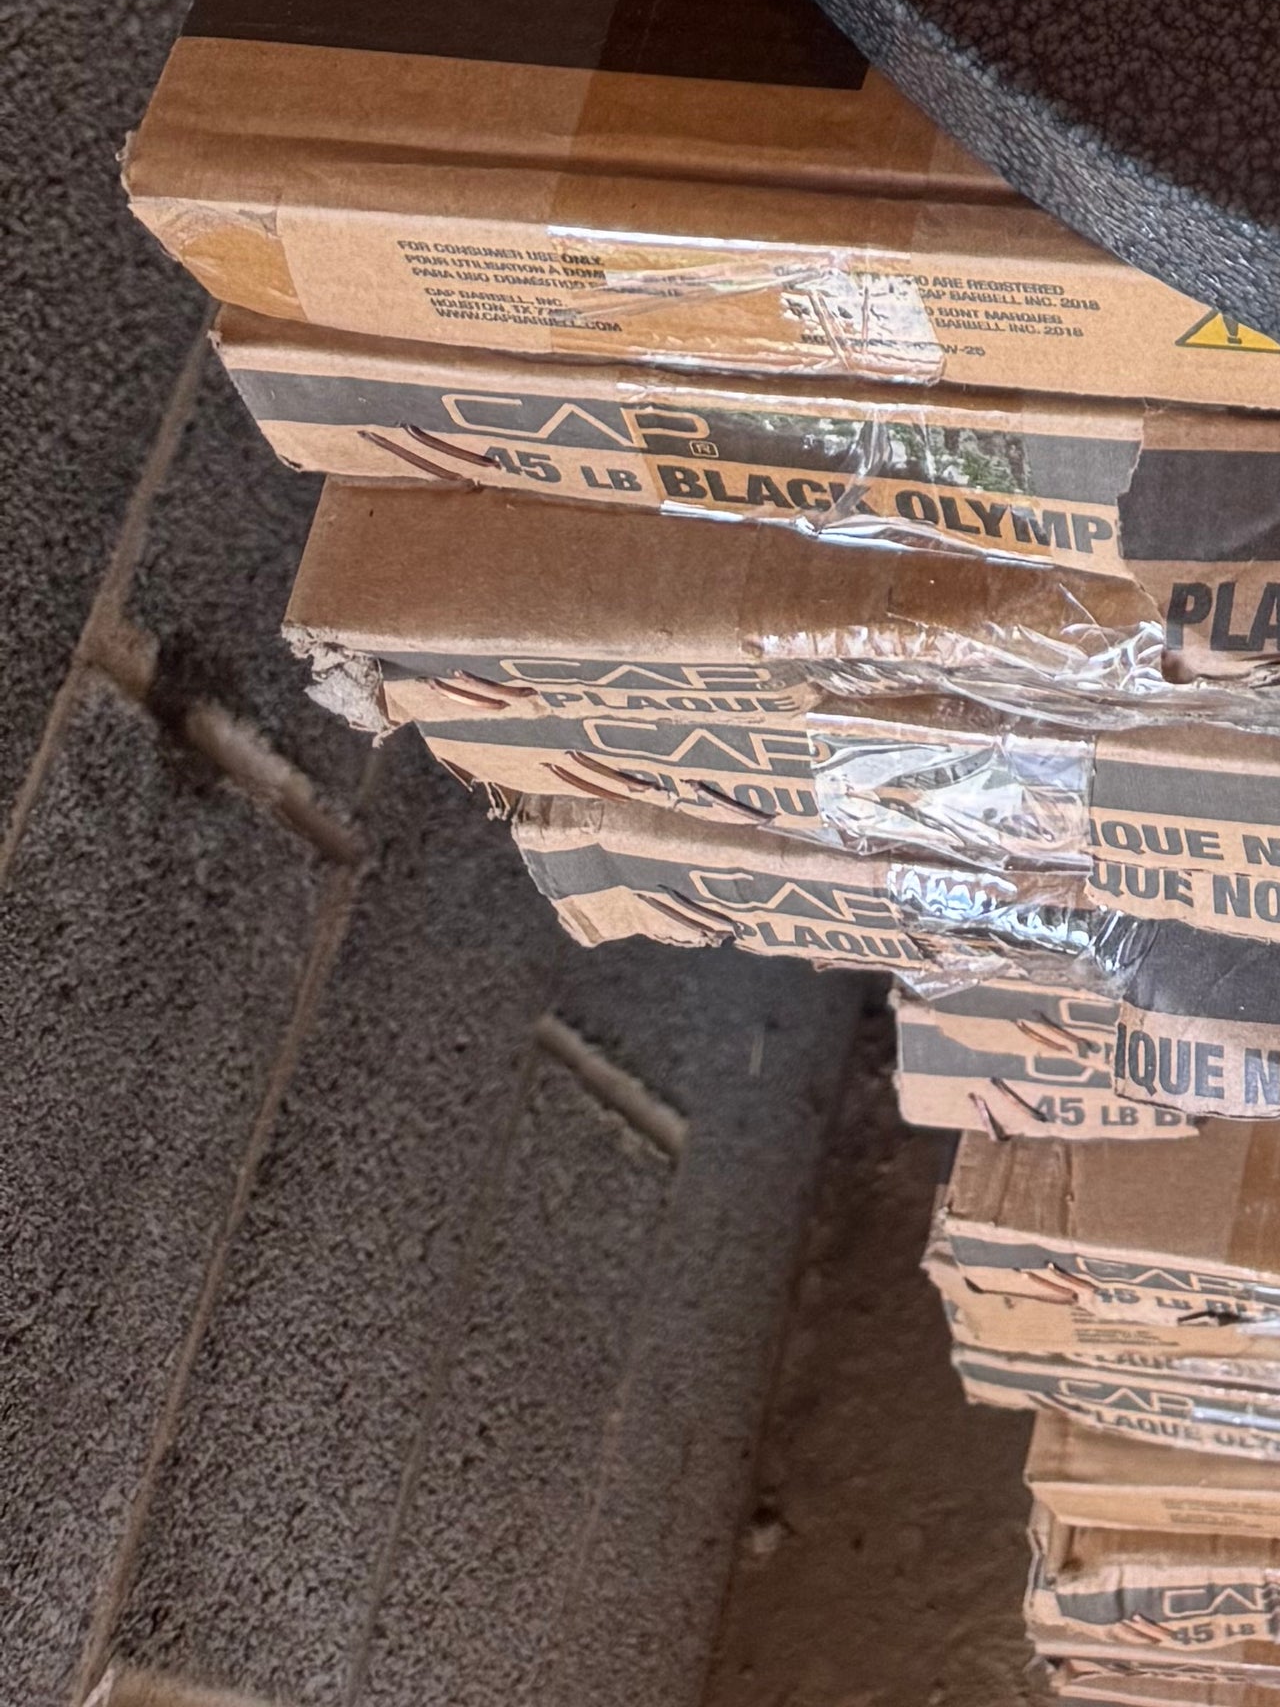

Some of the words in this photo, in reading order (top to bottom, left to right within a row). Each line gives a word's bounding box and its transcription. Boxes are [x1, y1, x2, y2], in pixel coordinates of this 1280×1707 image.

[397, 240, 431, 253] FOR
[433, 242, 524, 261] CONSUMER
[404, 254, 449, 268] POUR
[451, 257, 546, 276] UTILISATION
[412, 267, 454, 280] PARA
[424, 287, 456, 298] CAP
[932, 276, 964, 289] ARE
[966, 280, 1066, 297] REGISTERED
[949, 289, 1022, 306] BARBELL
[1025, 295, 1057, 308] INC.
[1060, 298, 1101, 312] 2018
[936, 318, 1006, 333] BARBELL
[1008, 325, 1041, 336] INC.
[1043, 327, 1085, 339] 2018
[984, 310, 1064, 325] MARQUES
[441, 393, 711, 448] CAP
[484, 445, 562, 484] 45
[580, 464, 644, 492] LB
[656, 464, 878, 517] BLACK
[894, 489, 1116, 555] OLYMP
[500, 659, 773, 689] CAP
[583, 718, 832, 771] CAP
[1113, 1021, 1226, 1100] IQUE
[1101, 1105, 1141, 1128] LB
